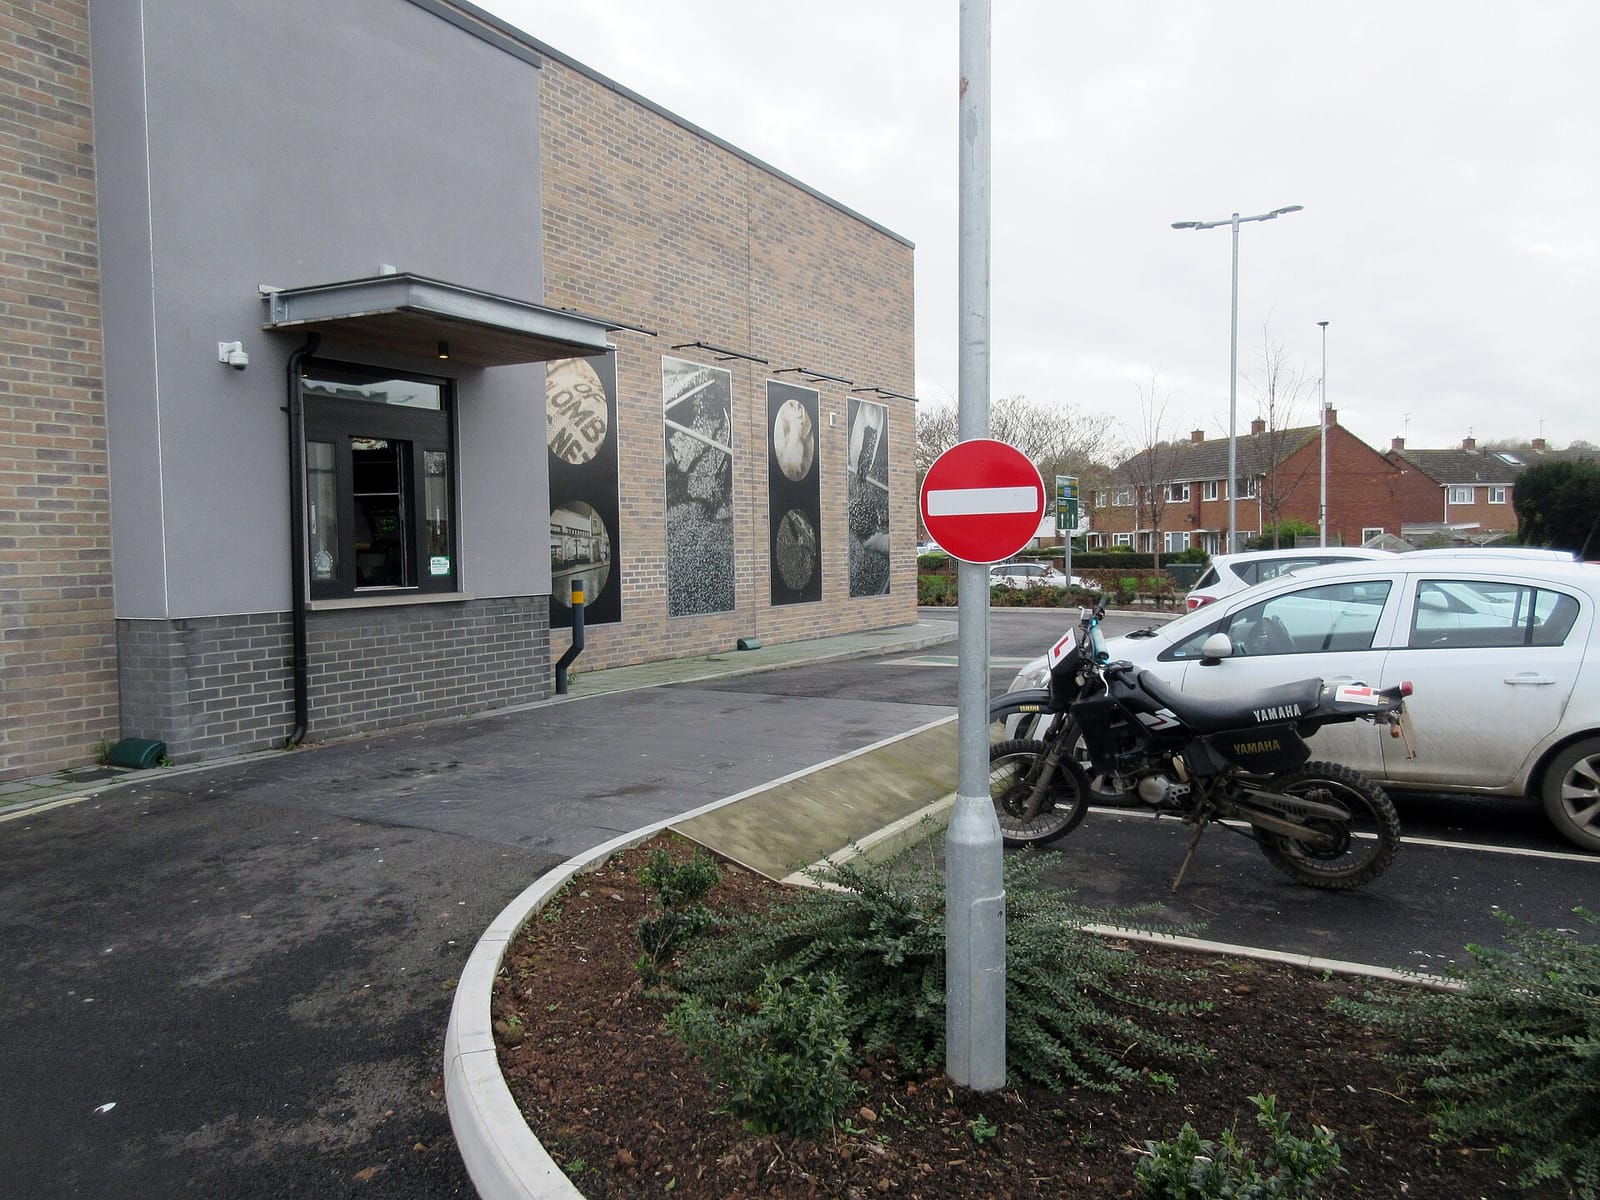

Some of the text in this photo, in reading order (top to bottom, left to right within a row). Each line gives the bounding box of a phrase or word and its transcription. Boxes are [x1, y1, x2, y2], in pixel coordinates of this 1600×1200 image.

[1019, 704, 1040, 712] YAMAHA
[1252, 703, 1302, 723] YAMAHA
[1233, 739, 1281, 755] YAMAHA
